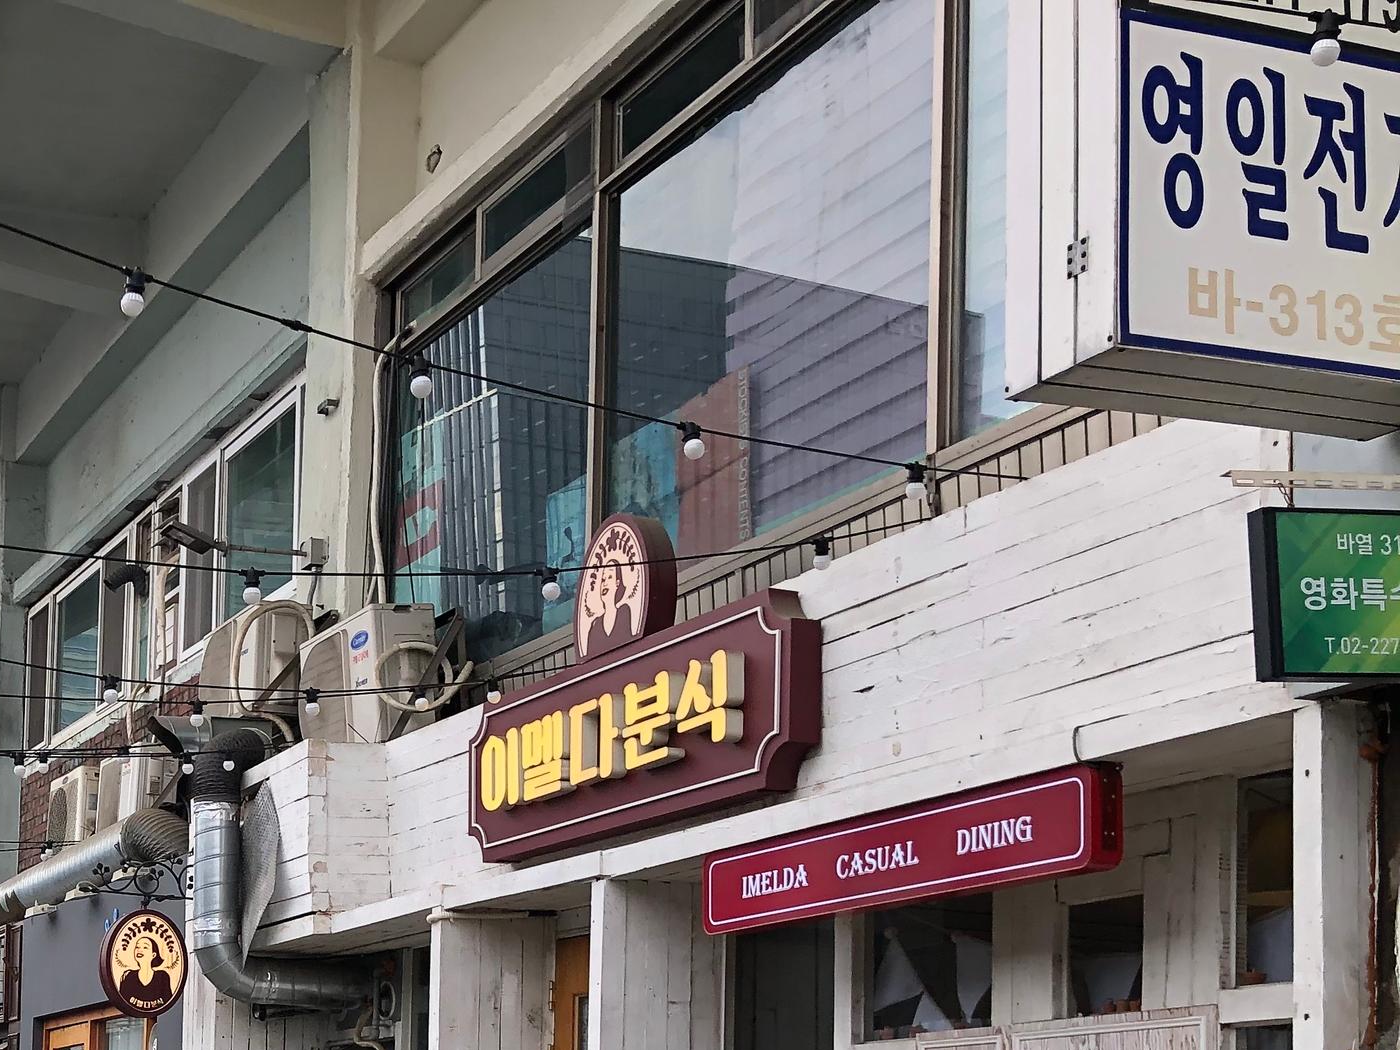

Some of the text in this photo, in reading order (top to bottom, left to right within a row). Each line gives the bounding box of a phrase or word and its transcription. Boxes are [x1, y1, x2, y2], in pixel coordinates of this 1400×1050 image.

[1337, 532, 1373, 555] 바열
[480, 648, 729, 813] 이멜다분식
[742, 815, 1032, 899] IMELDA CASUAL DINING
